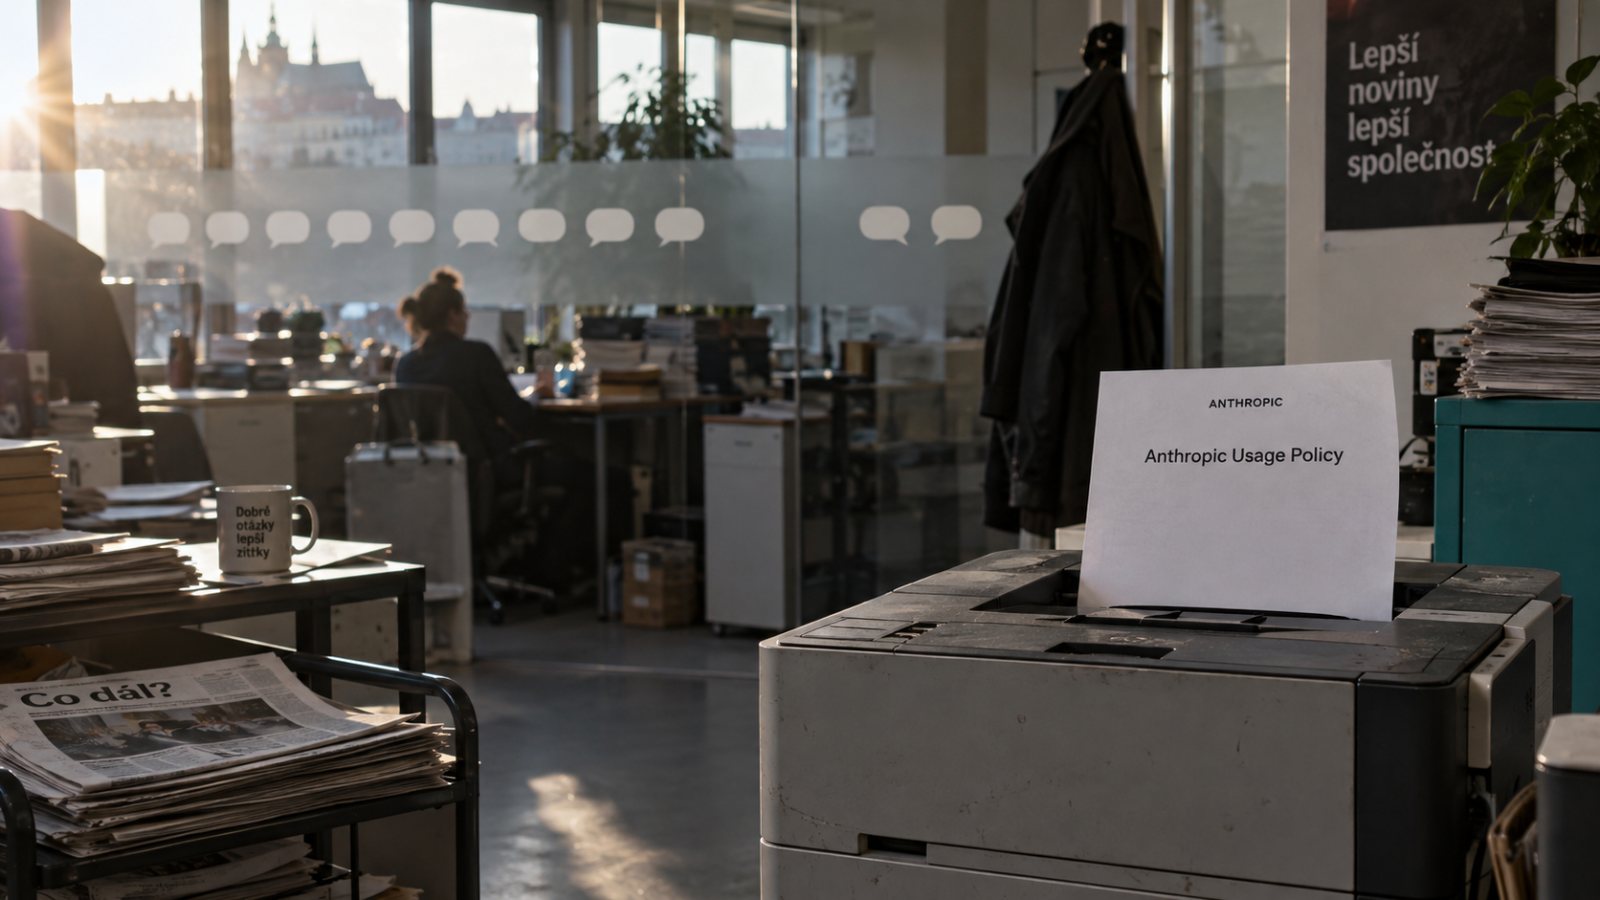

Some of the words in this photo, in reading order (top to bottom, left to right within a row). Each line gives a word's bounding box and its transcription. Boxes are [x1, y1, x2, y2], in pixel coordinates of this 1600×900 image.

[1349, 32, 1420, 73] Lepší
[1348, 71, 1440, 106] noviny
[1348, 107, 1411, 146] lepší
[1208, 397, 1284, 409] ANTHROPIC
[1144, 448, 1228, 467] Anthropic
[1232, 448, 1286, 466] Usage
[1291, 446, 1344, 466] Policy
[20, 692, 81, 708] Co
[89, 681, 172, 703] dál?
